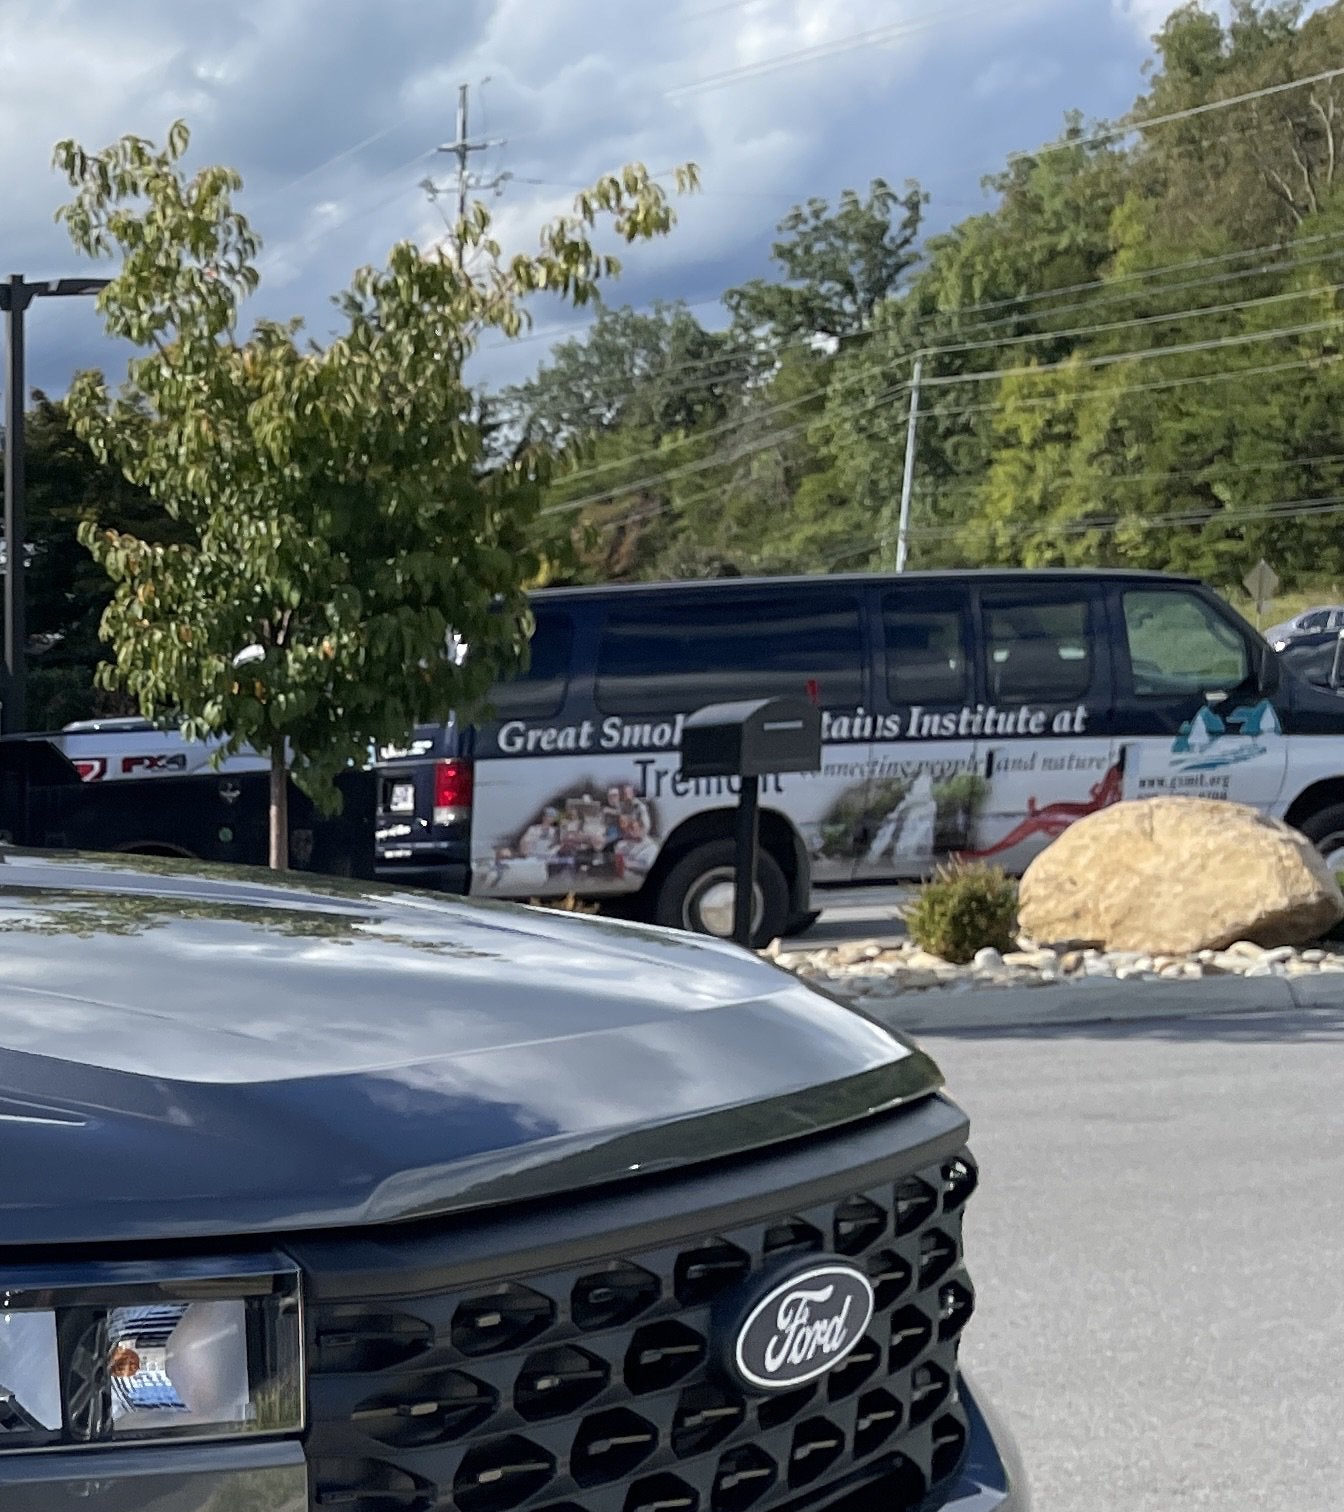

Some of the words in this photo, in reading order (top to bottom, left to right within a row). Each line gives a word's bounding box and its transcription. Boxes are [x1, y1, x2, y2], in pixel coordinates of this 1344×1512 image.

[497, 720, 595, 752] Great
[599, 714, 686, 748] Smo
[905, 704, 1046, 737] Institute
[1052, 706, 1088, 733] at
[121, 753, 188, 774] FX4
[764, 1284, 852, 1373] Ford
